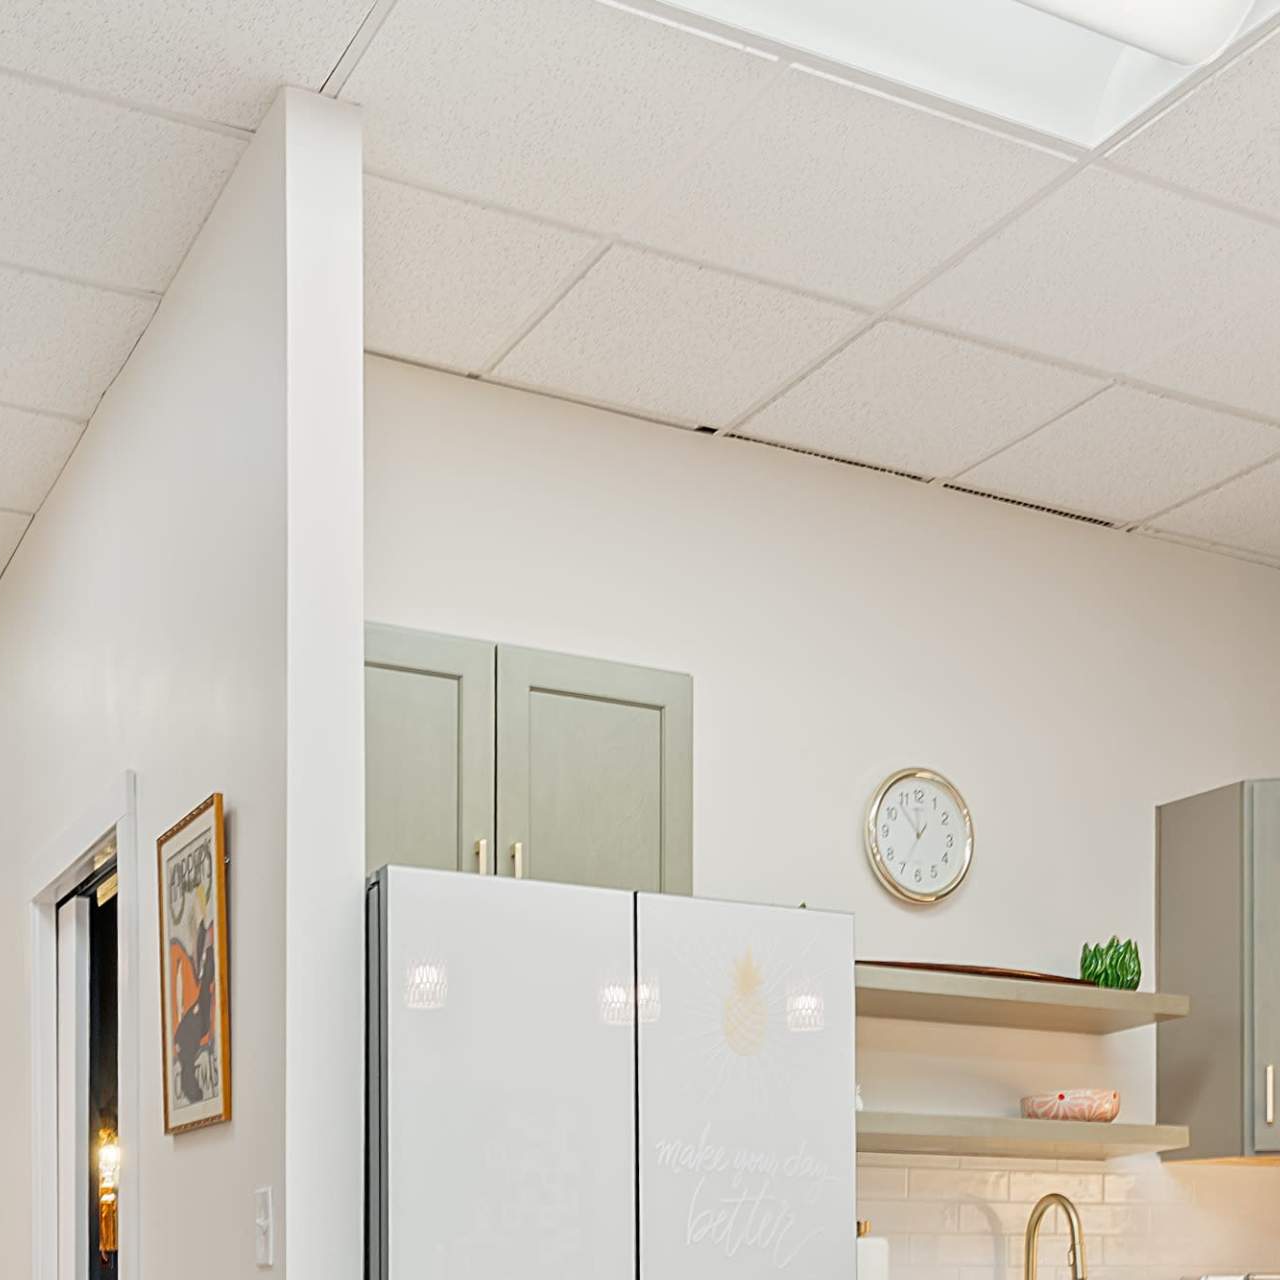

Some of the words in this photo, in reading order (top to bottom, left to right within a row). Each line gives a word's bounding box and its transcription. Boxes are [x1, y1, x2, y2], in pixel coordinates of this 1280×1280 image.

[899, 792, 909, 806] 11
[913, 789, 924, 804] 12
[932, 797, 937, 810] 1
[886, 806, 897, 821] 10
[941, 812, 949, 826] 2
[882, 824, 889, 839] 9
[946, 834, 953, 848] 3
[887, 847, 894, 861] 8
[941, 852, 948, 864] 4
[899, 862, 906, 874] 7
[930, 865, 938, 879] 5
[914, 869, 922, 883] 6
